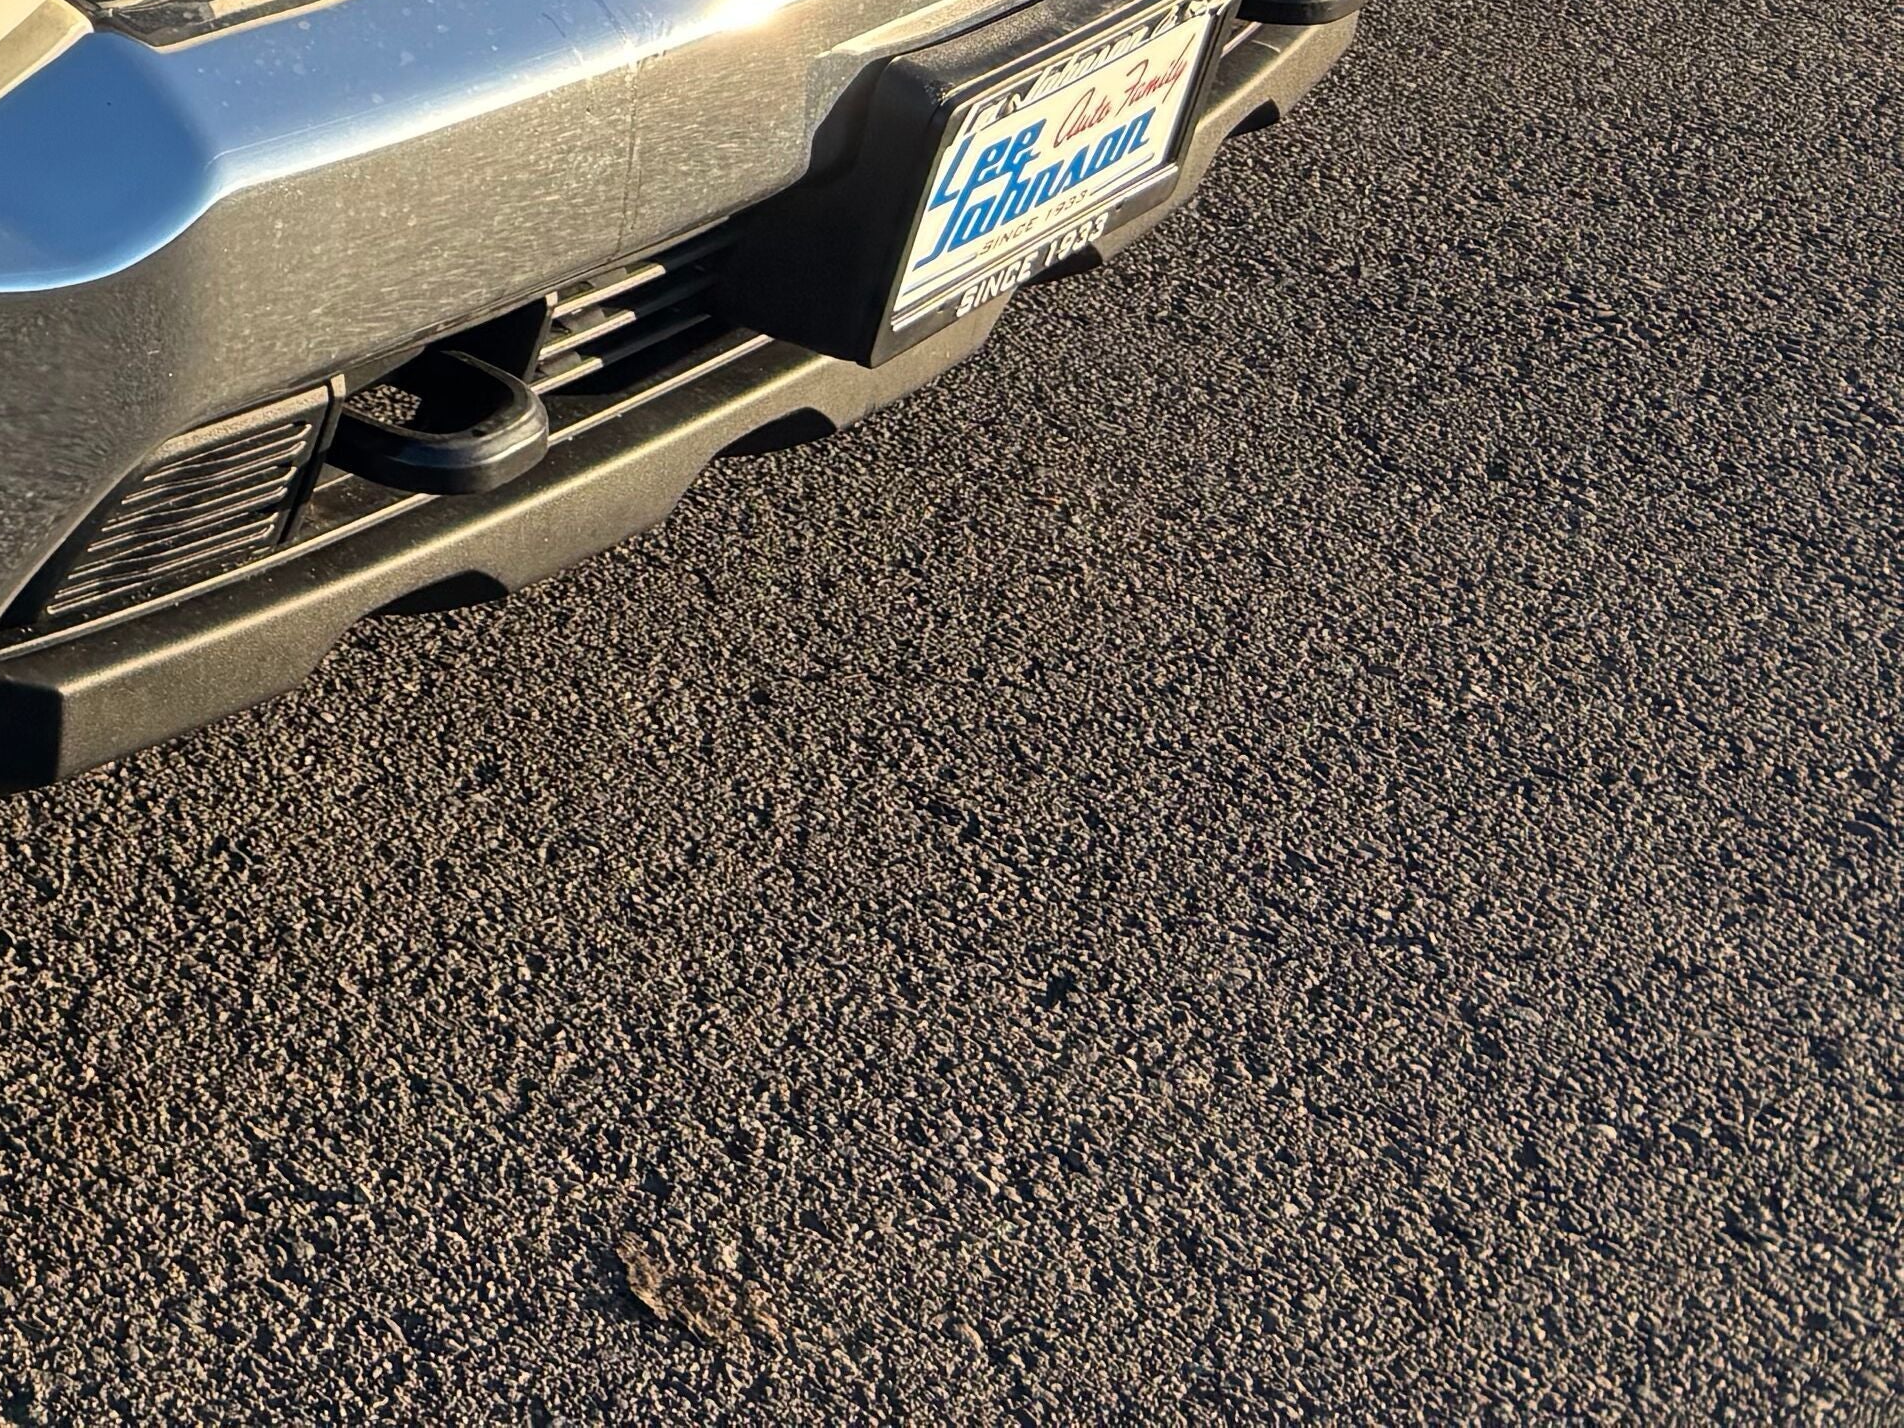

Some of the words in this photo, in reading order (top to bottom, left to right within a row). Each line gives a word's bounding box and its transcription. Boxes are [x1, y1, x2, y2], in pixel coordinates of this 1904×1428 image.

[913, 107, 1157, 272] Johnson
[929, 118, 1047, 211] Lee
[1053, 87, 1112, 148] Auto
[1115, 33, 1196, 120] Family
[956, 251, 1040, 318] SINCE
[1044, 213, 1109, 267] 1933
[977, 216, 1039, 256] SINCE
[1044, 189, 1088, 222] 1933
